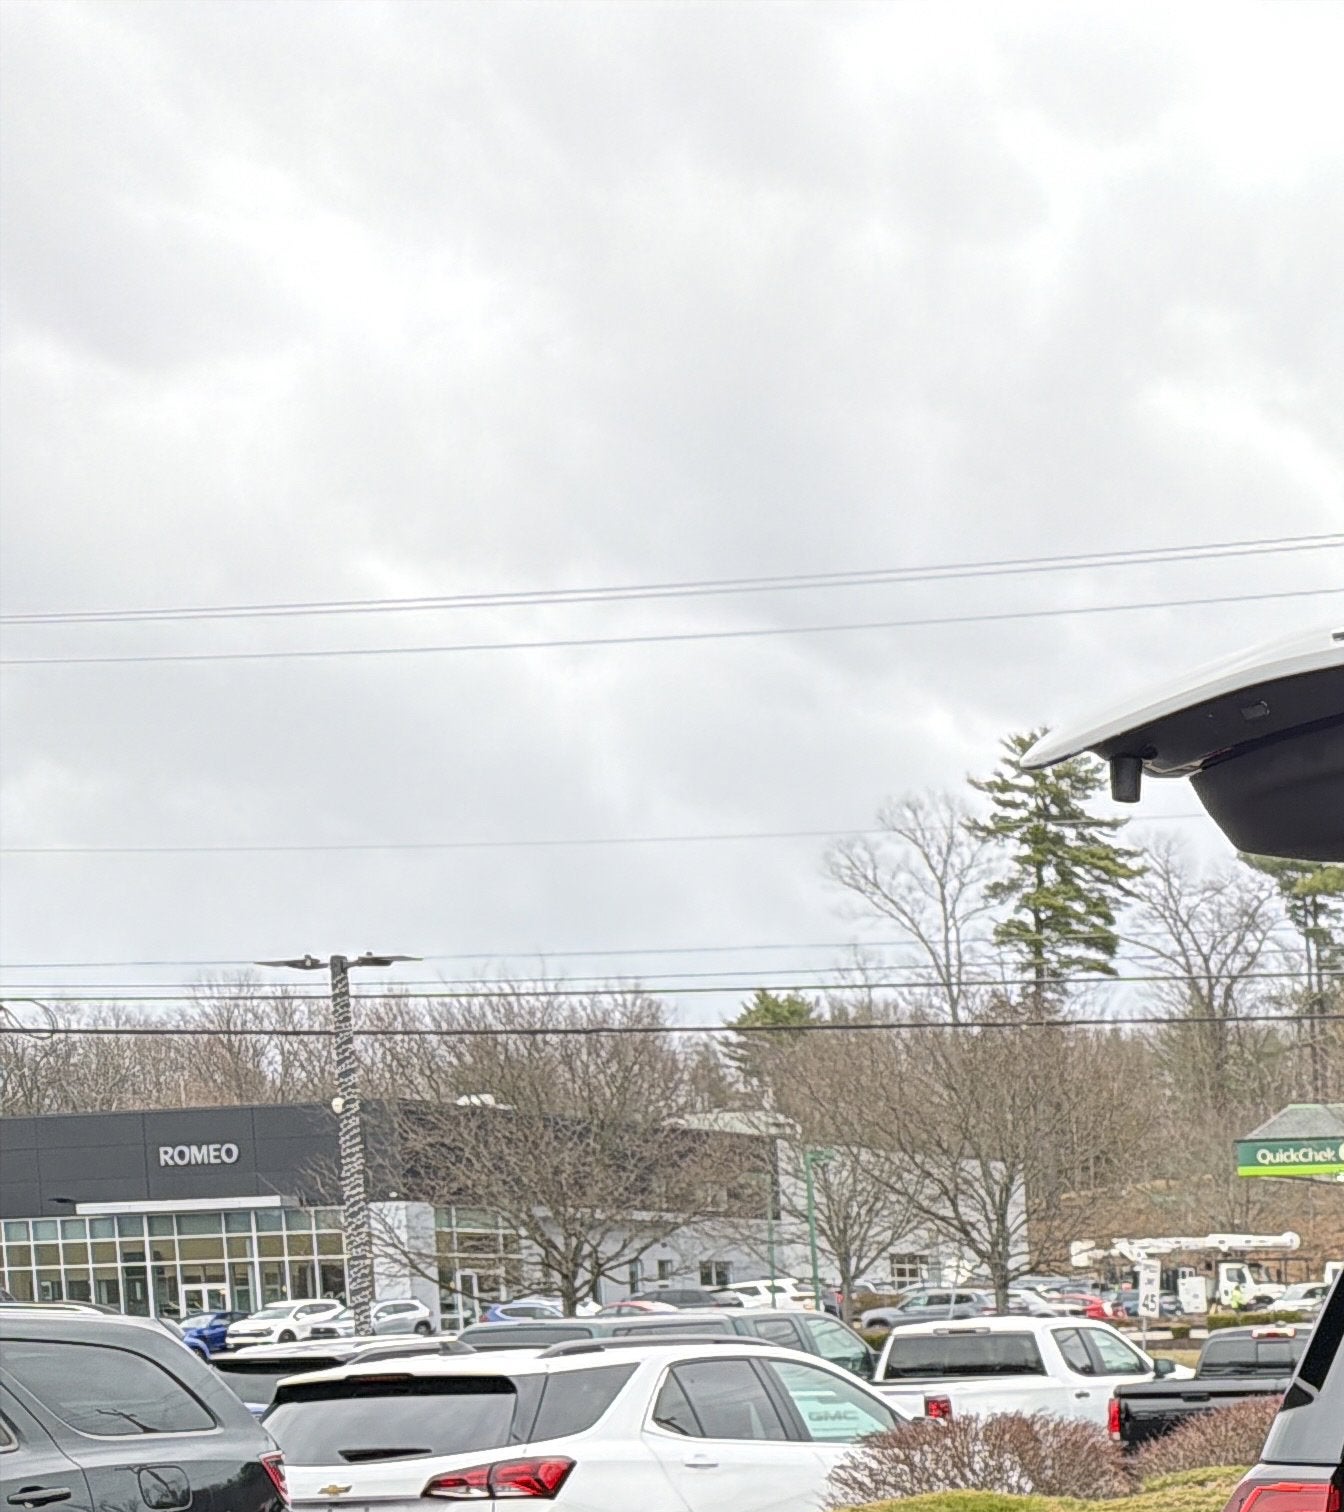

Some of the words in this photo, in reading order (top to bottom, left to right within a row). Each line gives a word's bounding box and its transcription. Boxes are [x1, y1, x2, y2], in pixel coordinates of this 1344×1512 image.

[159, 1143, 239, 1166] ROMEO
[1256, 1146, 1337, 1165] QuickChek
[1142, 1293, 1157, 1312] 45
[808, 1410, 860, 1421] GMC
